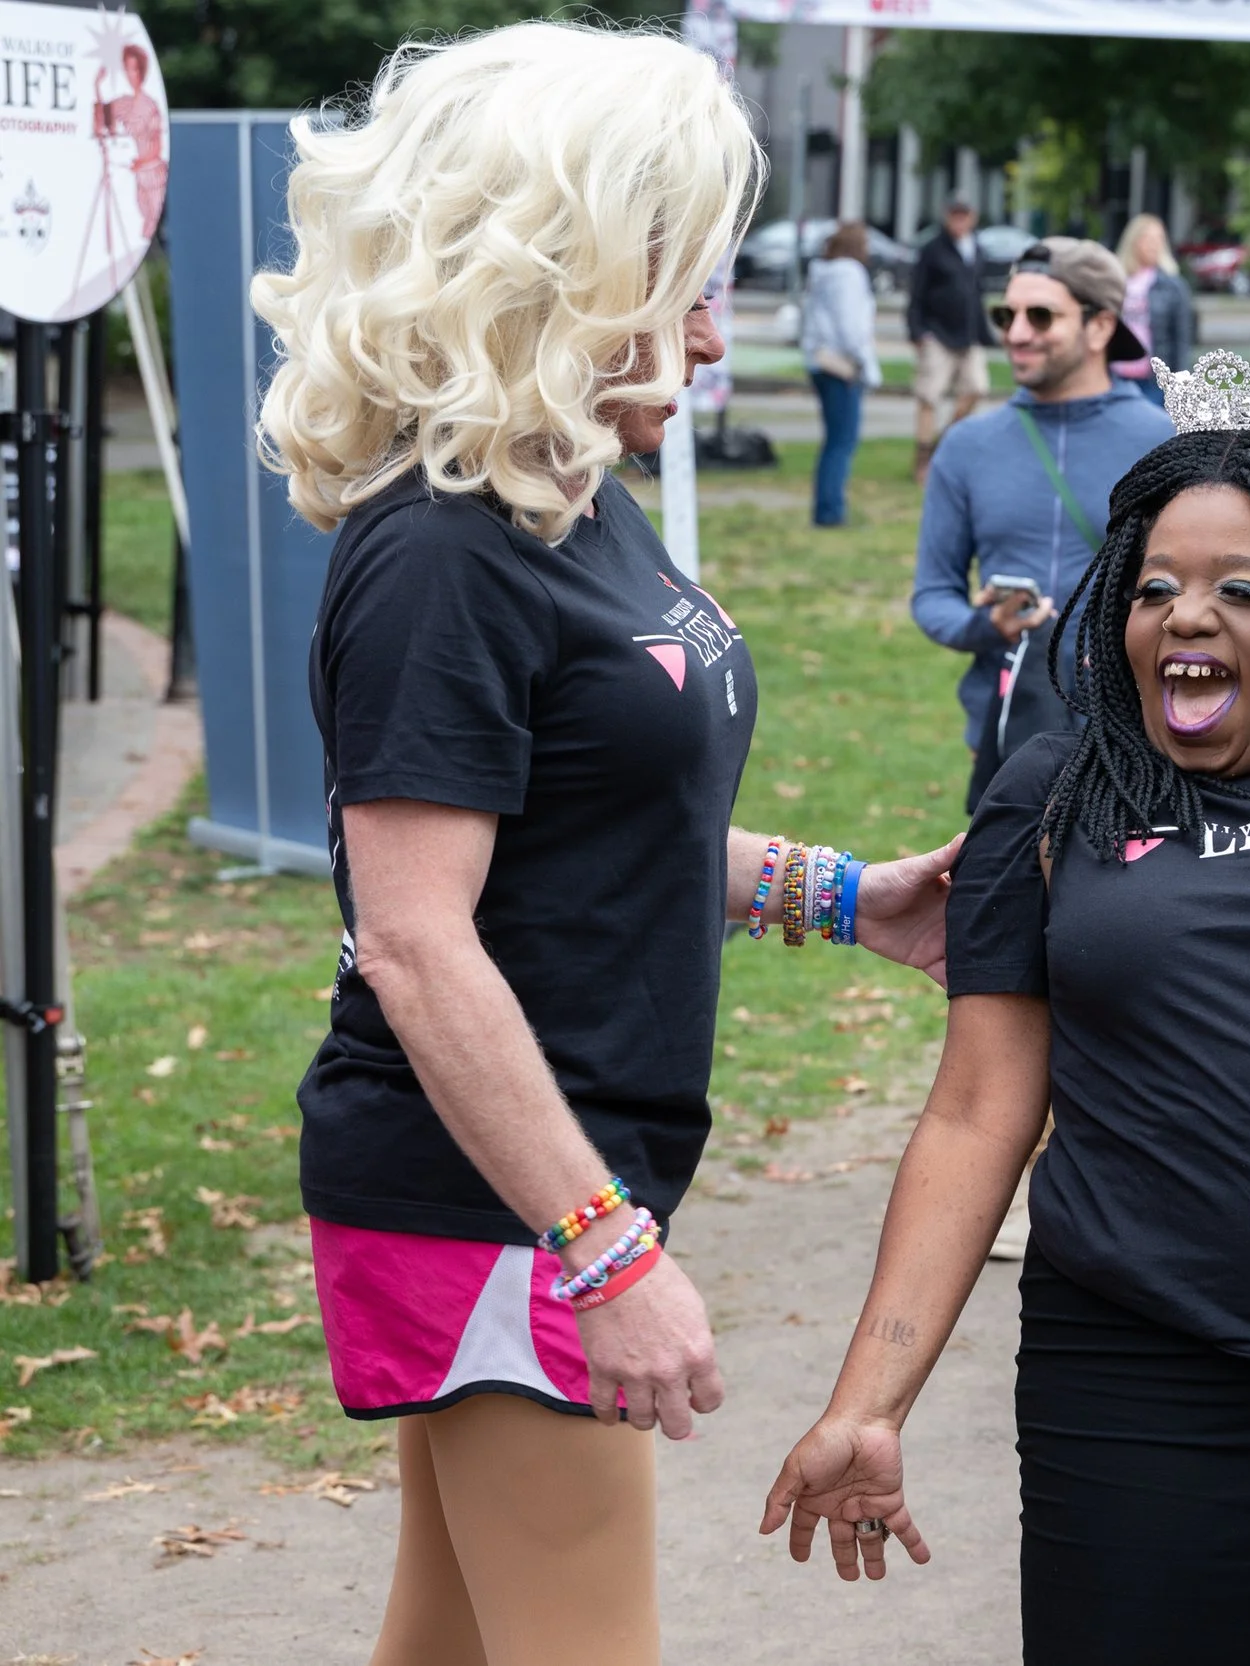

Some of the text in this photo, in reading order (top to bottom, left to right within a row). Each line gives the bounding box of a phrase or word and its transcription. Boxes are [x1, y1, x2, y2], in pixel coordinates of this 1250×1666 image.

[3, 37, 52, 55] WALKS
[3, 59, 76, 110] IFE
[0, 118, 77, 134] OTOGRAPHY
[678, 609, 733, 667] LIFE
